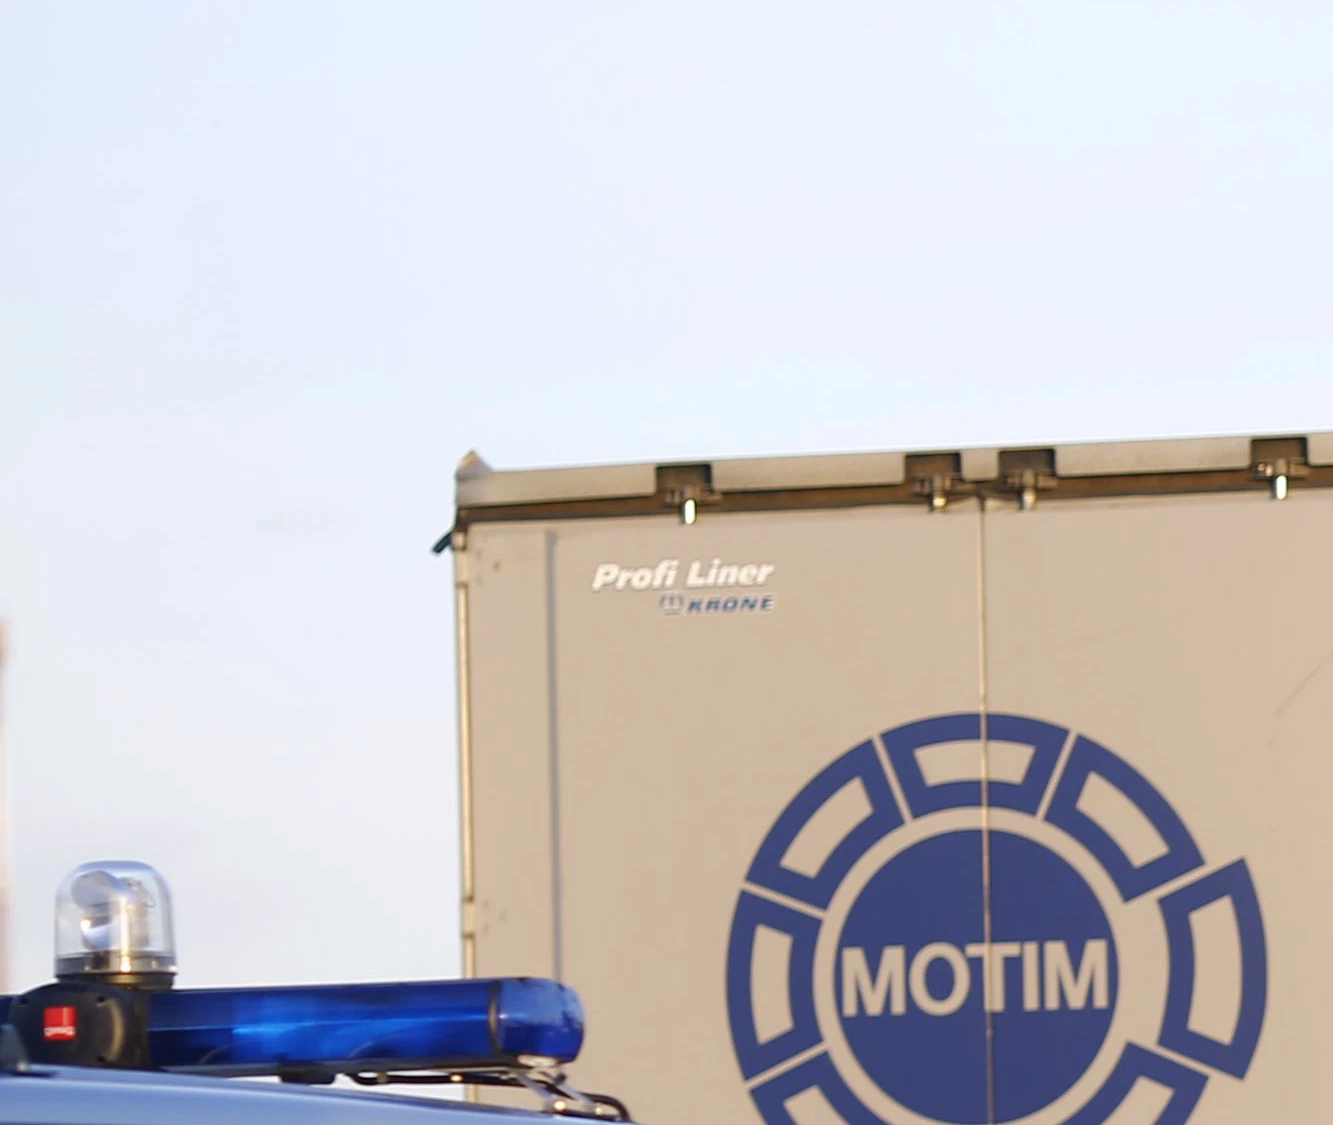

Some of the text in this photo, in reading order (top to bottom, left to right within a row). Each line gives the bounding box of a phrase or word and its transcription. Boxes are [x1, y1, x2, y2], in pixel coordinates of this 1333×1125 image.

[591, 558, 776, 592] Profi Liner
[687, 594, 776, 614] KRONE
[841, 938, 1109, 1018] MOTIM
